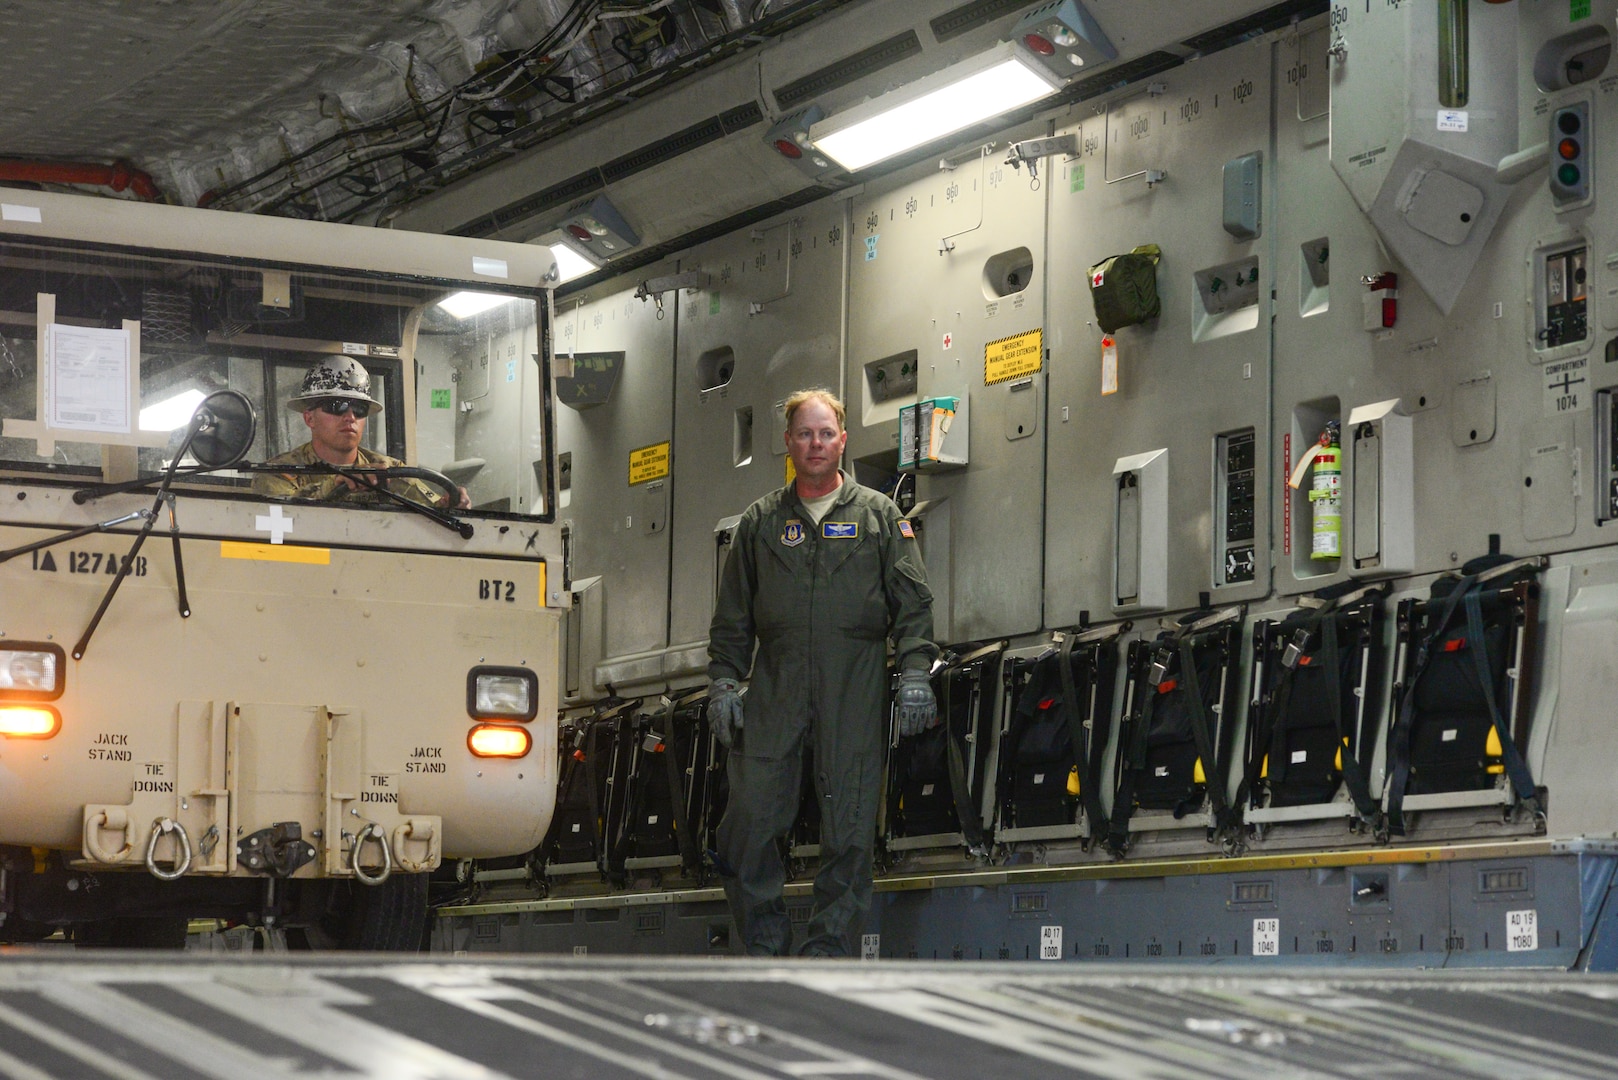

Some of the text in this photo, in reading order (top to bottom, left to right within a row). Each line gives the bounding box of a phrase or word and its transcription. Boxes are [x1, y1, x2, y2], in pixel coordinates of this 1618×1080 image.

[1233, 81, 1253, 101] 1020
[1180, 100, 1199, 119] 1010
[1130, 118, 1148, 136] 1000
[1085, 136, 1099, 152] 990
[990, 170, 1002, 184] 970
[946, 185, 958, 200] 960
[906, 200, 917, 214] 950
[867, 215, 878, 229] 940
[829, 228, 840, 243] 930
[792, 241, 802, 256] 920
[756, 254, 766, 268] 910
[1002, 339, 1024, 352] EMERGENCY
[990, 346, 1037, 364] MANUAL GEAR EXTENSION
[1546, 358, 1587, 375] COMPARTMENT
[1556, 395, 1577, 411] 1074
[479, 579, 515, 601] BT2
[94, 733, 128, 745] JACK
[89, 749, 132, 761] STAND
[410, 747, 441, 758] JACK
[145, 764, 164, 775] TIE
[406, 762, 446, 773] STAND
[134, 781, 173, 792] DOWN
[371, 776, 389, 786] TIE
[361, 792, 398, 803] DOWN
[1511, 913, 1533, 924] AD 19
[1258, 921, 1266, 932] AD
[1044, 928, 1059, 938] AD 17
[864, 936, 870, 945] AD
[1258, 941, 1274, 952] 1040
[1317, 940, 1333, 952] 1050
[1380, 939, 1397, 952] 1060
[1445, 937, 1464, 950] 1070
[1513, 935, 1532, 948] 1080
[999, 949, 1009, 959] 990
[1044, 946, 1058, 957] 1000
[1095, 944, 1109, 955] 1010
[1147, 944, 1162, 955] 1020
[1201, 944, 1216, 955] 1030
